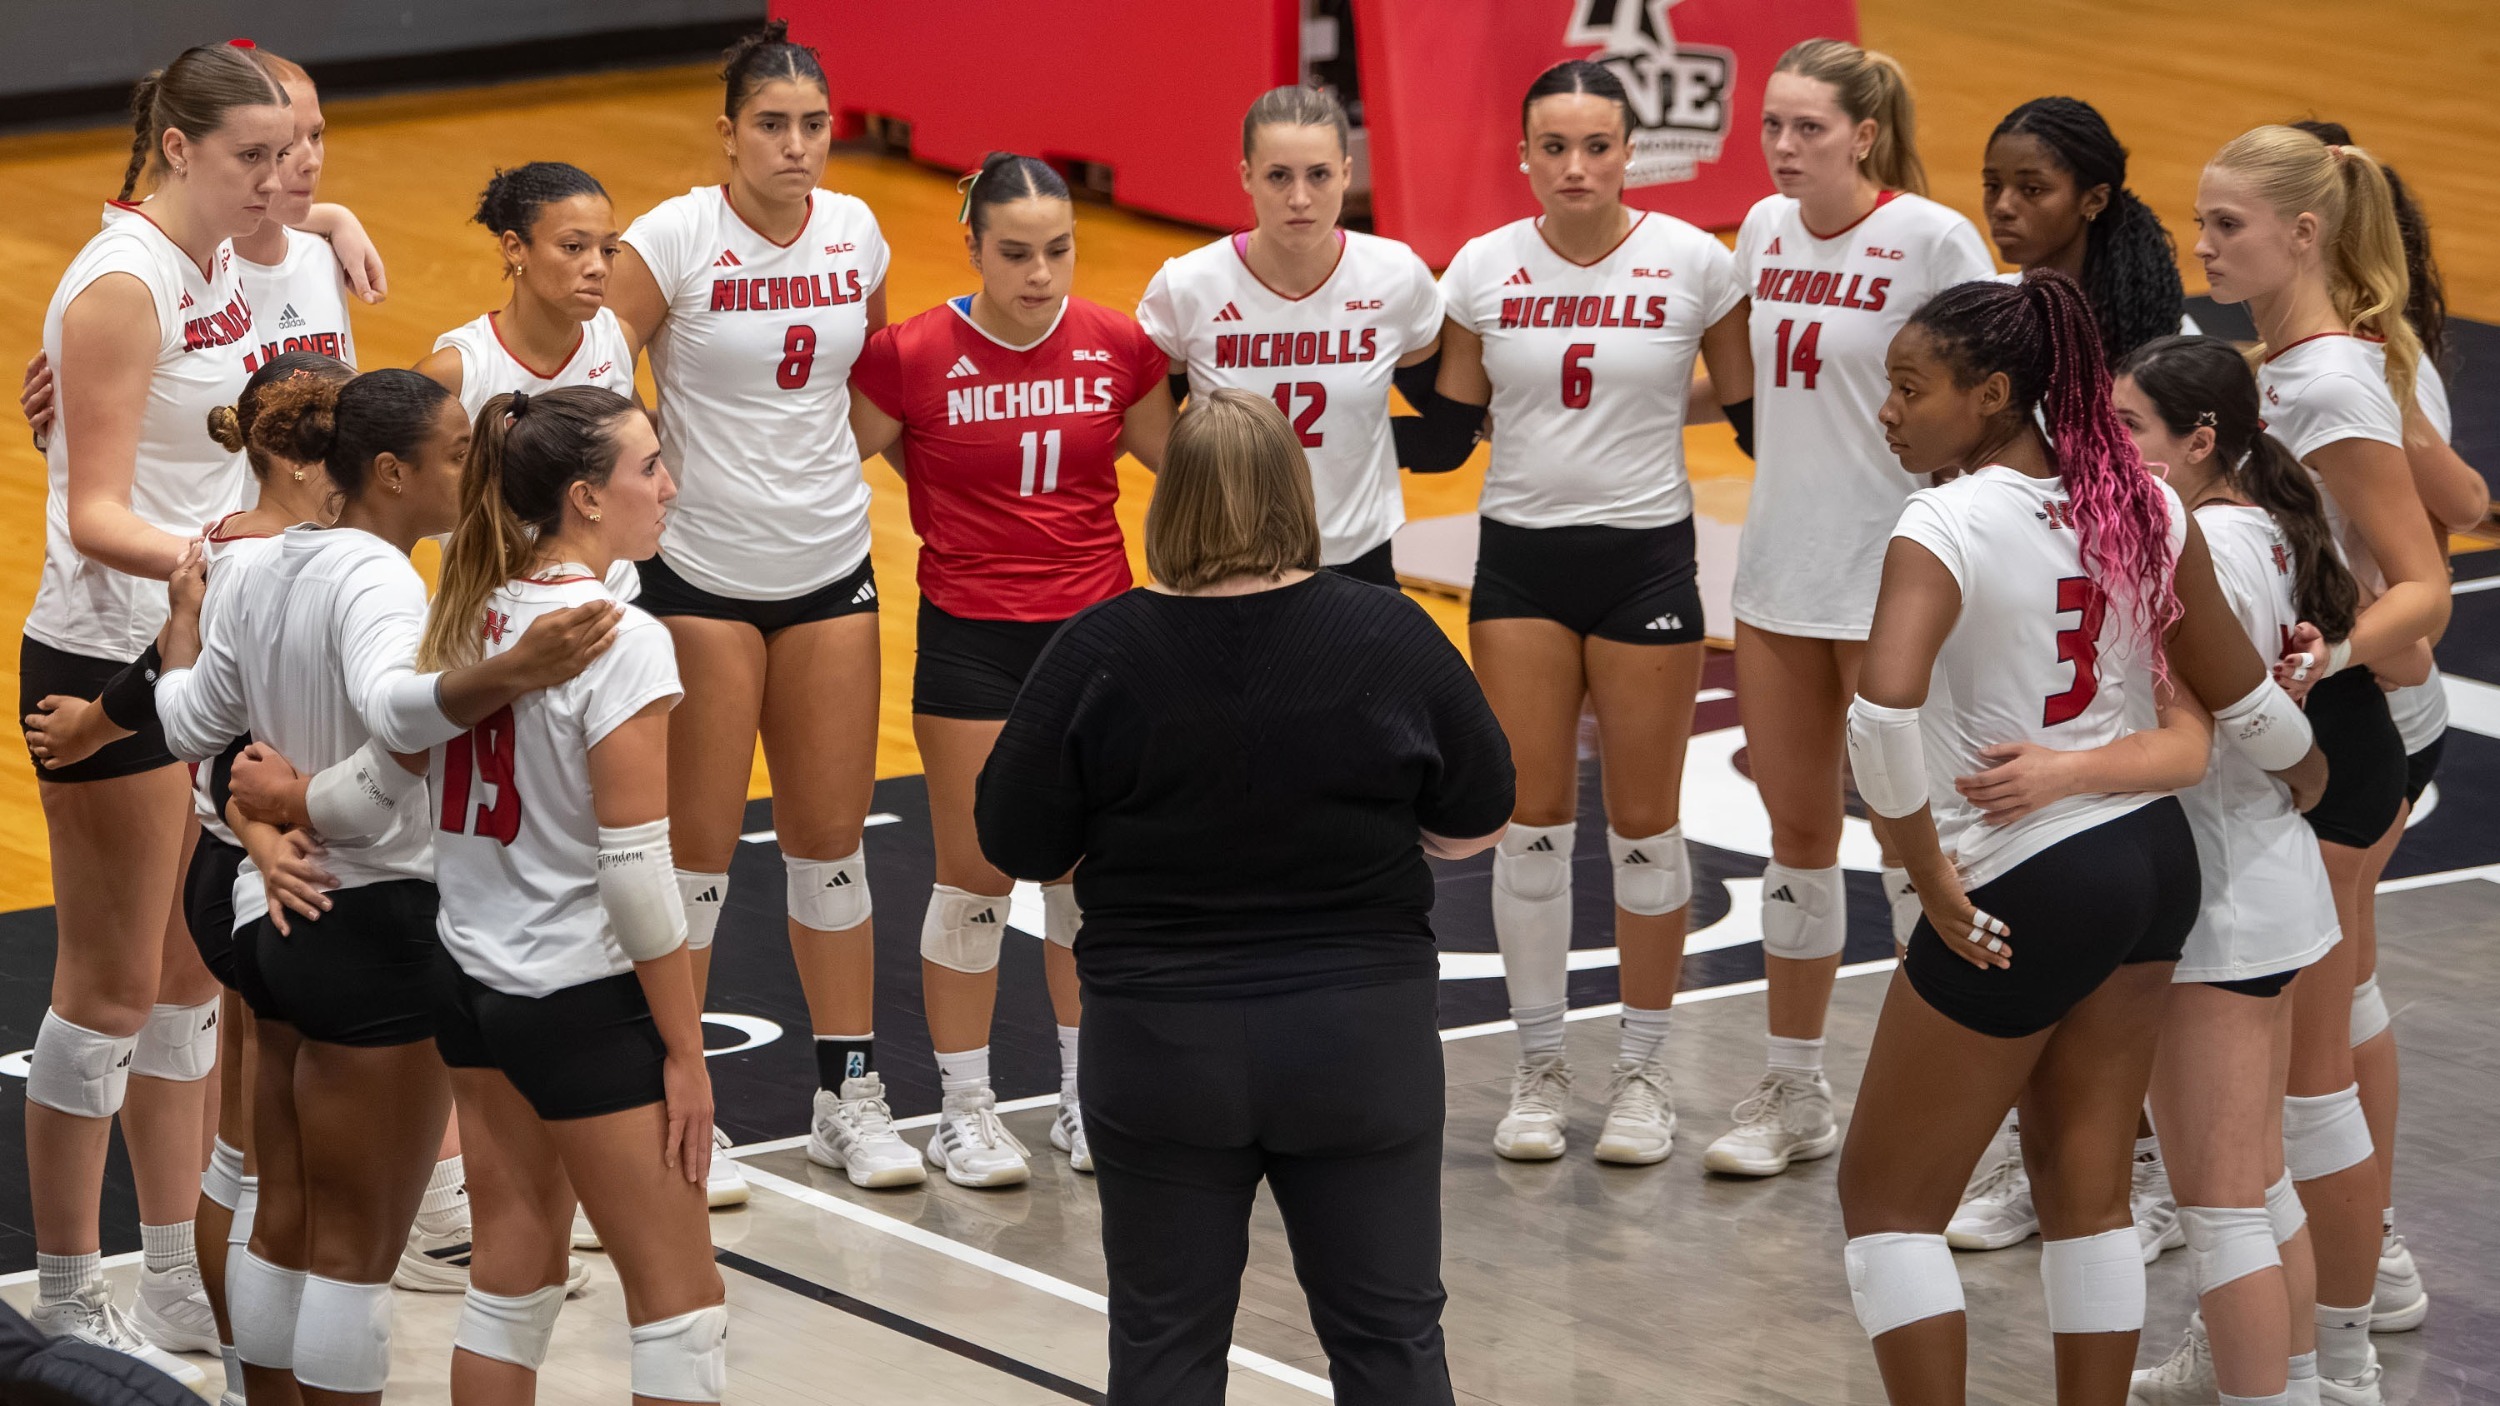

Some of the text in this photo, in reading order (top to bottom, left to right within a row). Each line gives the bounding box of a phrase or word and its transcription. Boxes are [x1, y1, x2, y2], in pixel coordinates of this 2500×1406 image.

[825, 242, 856, 255] SLC
[710, 269, 863, 311] NICHOLLS
[1499, 295, 1667, 329] NICHOLLS
[1756, 268, 1892, 312] NICHOLLS
[278, 318, 306, 330] adidas
[1215, 328, 1377, 368] NICHOLLS
[776, 324, 817, 390] 8
[1072, 349, 1113, 361] SLC
[1562, 343, 1596, 410] 6
[1775, 318, 1823, 390] 14
[946, 377, 1113, 426] NICHOLLS
[1272, 381, 1327, 448] 12
[1019, 429, 1061, 497] 11
[2042, 576, 2107, 728] 3
[439, 703, 522, 847] 19
